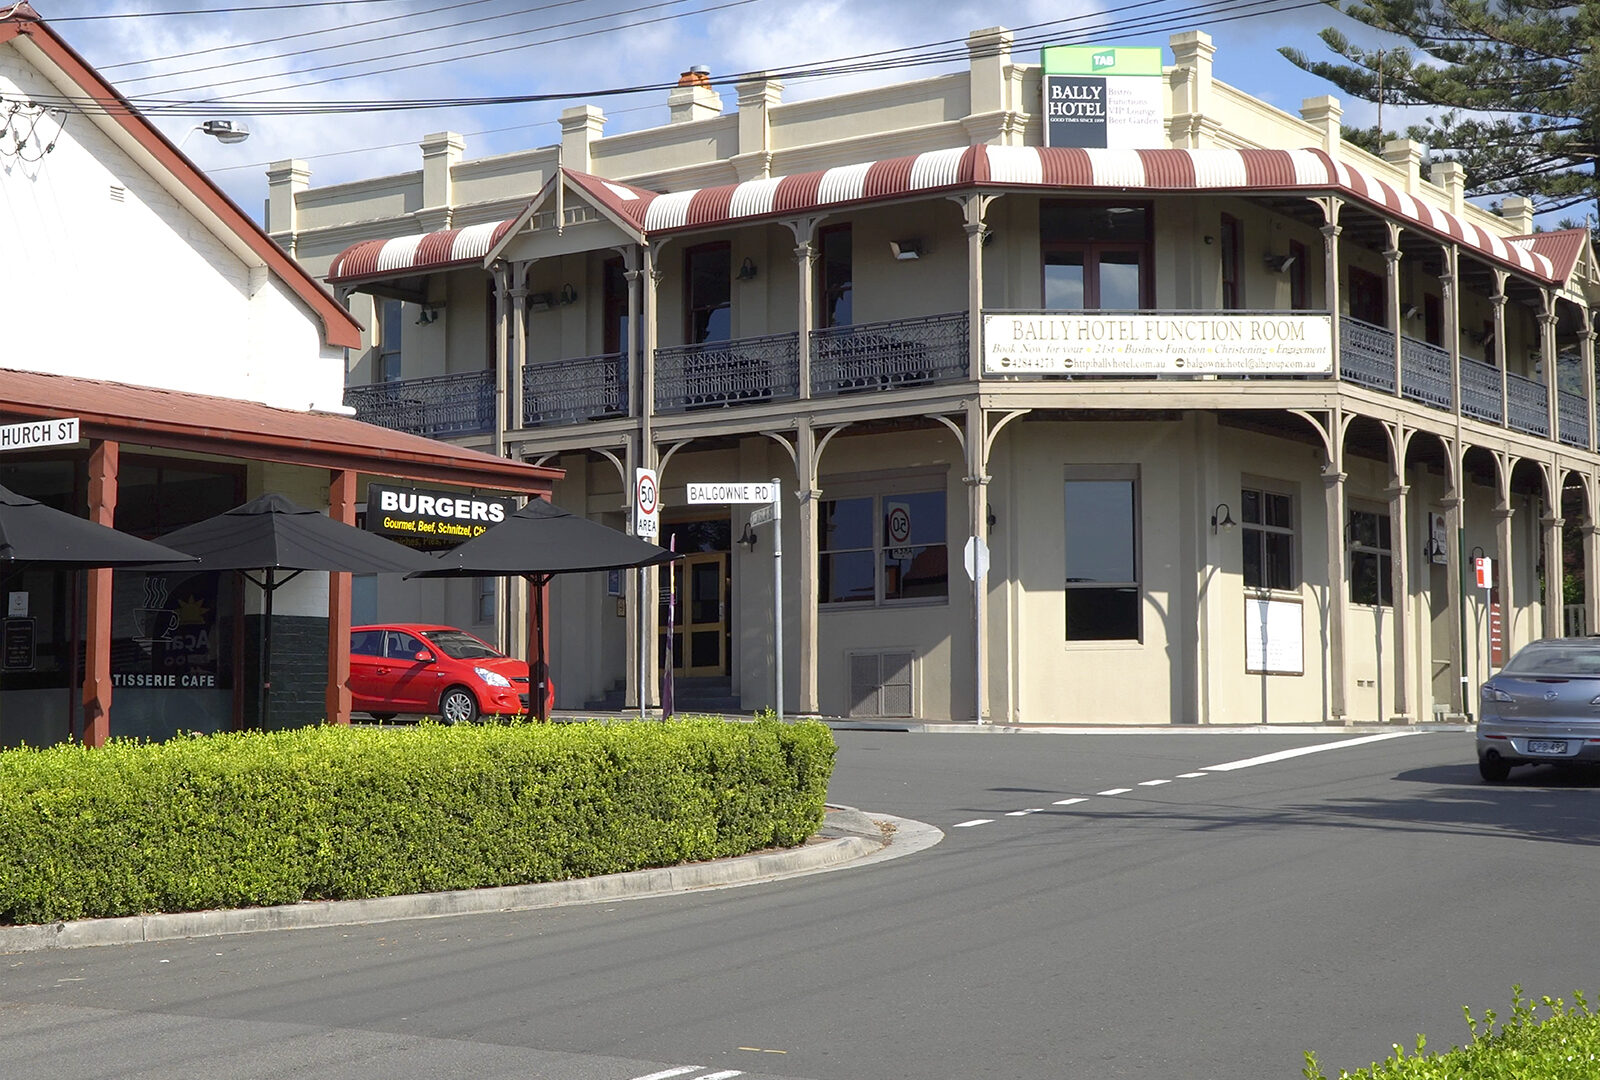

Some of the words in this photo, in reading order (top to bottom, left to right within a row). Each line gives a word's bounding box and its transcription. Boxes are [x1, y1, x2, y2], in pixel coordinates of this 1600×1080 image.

[1093, 55, 1114, 66] TAB
[1051, 85, 1102, 99] BALLY
[1049, 102, 1105, 116] HOTEL
[1012, 320, 1071, 340] BALLY
[1077, 320, 1140, 341] HOTEL
[1145, 320, 1242, 341] FUNCTION
[1250, 320, 1305, 341] ROOM
[992, 343, 1016, 354] Book
[1124, 343, 1163, 354] Business
[1165, 343, 1206, 354] Function
[1214, 343, 1267, 356] Christening
[2, 424, 51, 446] HURCH
[58, 422, 74, 440] ST
[641, 485, 654, 504] 50
[690, 486, 749, 500] BALGOWNIE
[755, 486, 768, 500] RD
[381, 490, 505, 523] BURGERS
[383, 516, 417, 533] Gourmet,
[418, 520, 437, 534] Beef,
[438, 522, 472, 538] Schnitzel,
[473, 526, 487, 537] Chi
[638, 519, 657, 532] AREA
[113, 674, 176, 686] TISSERIE
[181, 675, 215, 687] CAFE
